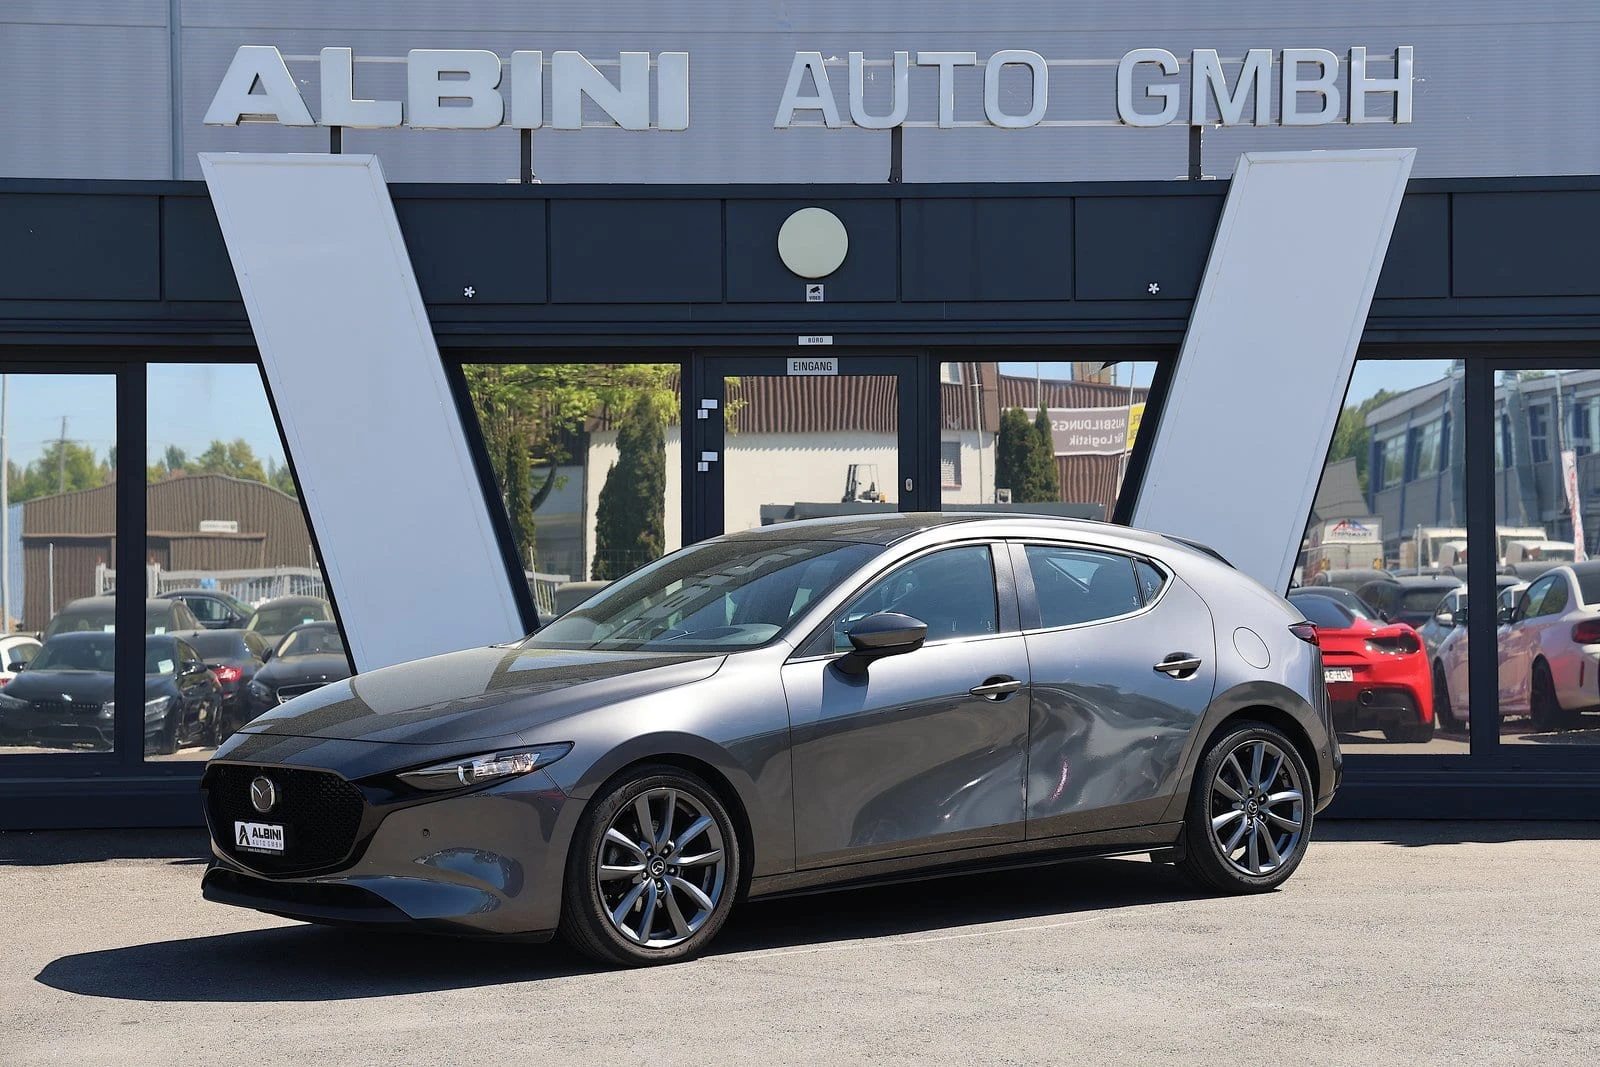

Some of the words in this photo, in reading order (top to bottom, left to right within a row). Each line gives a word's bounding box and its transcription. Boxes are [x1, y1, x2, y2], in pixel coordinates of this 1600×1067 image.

[203, 45, 690, 132] ALBINI
[774, 50, 1049, 129] AUTO
[1116, 45, 1414, 128] GMBH
[793, 361, 833, 371] EINGANG
[252, 827, 281, 840] ALBINI
